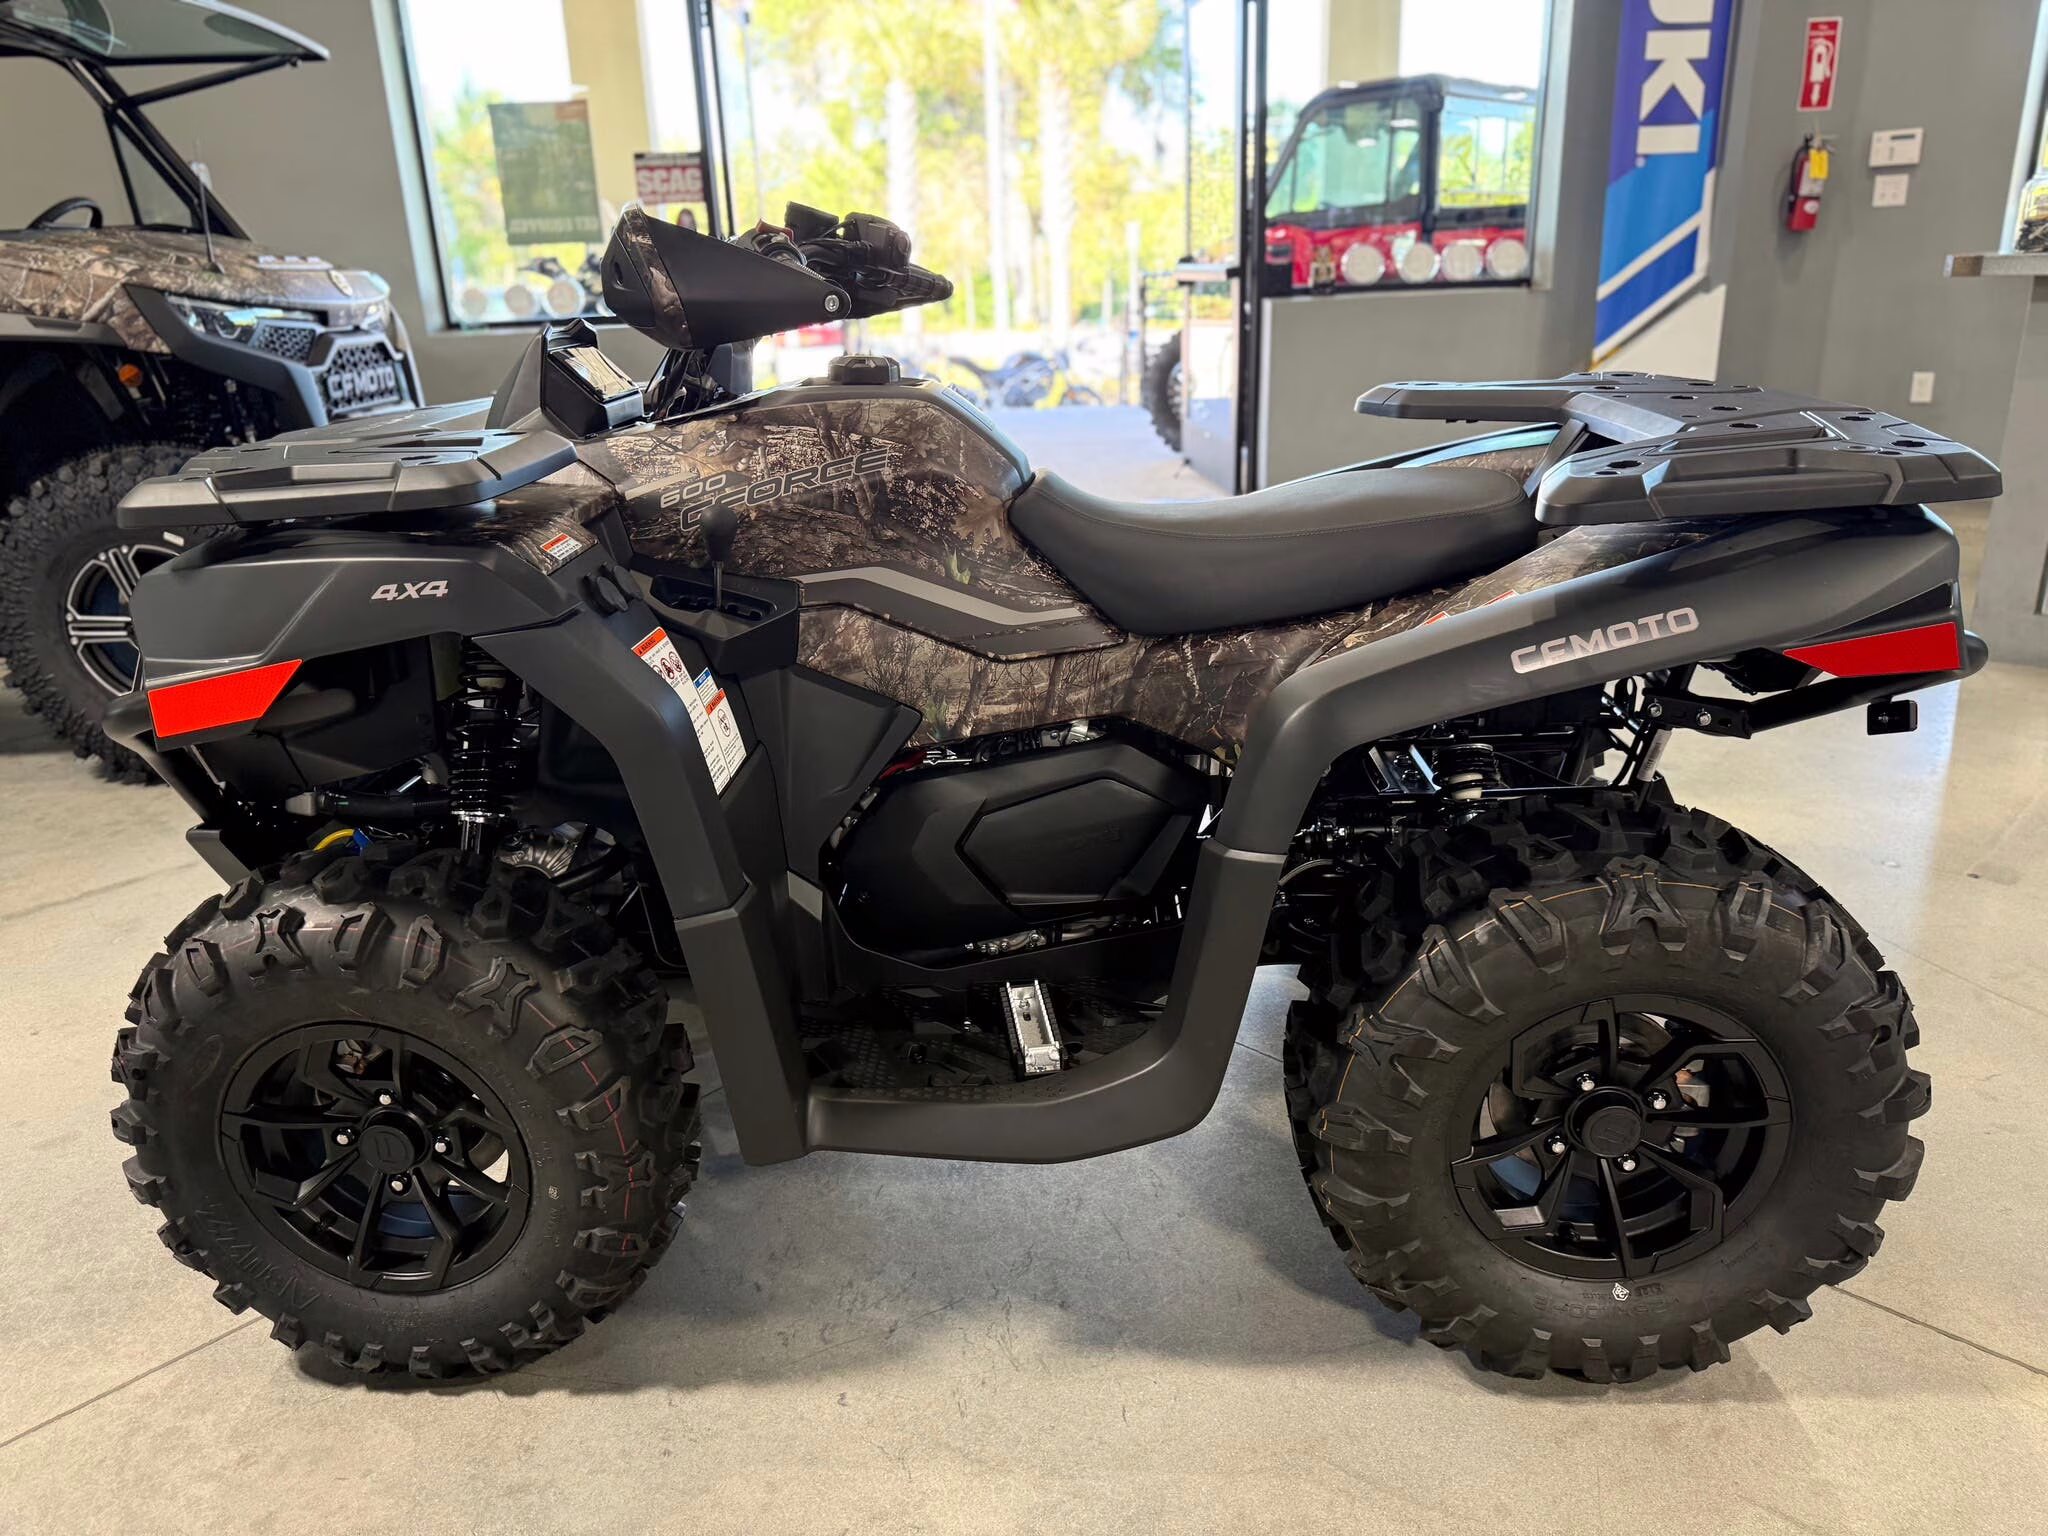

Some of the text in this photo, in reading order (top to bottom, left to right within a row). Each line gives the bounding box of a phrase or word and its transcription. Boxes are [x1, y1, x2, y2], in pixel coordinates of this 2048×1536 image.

[1636, 0, 1715, 155] KI
[638, 168, 702, 193] SCAG
[327, 366, 396, 399] CFMOTO
[660, 473, 727, 508] 600
[1510, 607, 1699, 674] CFMOTO
